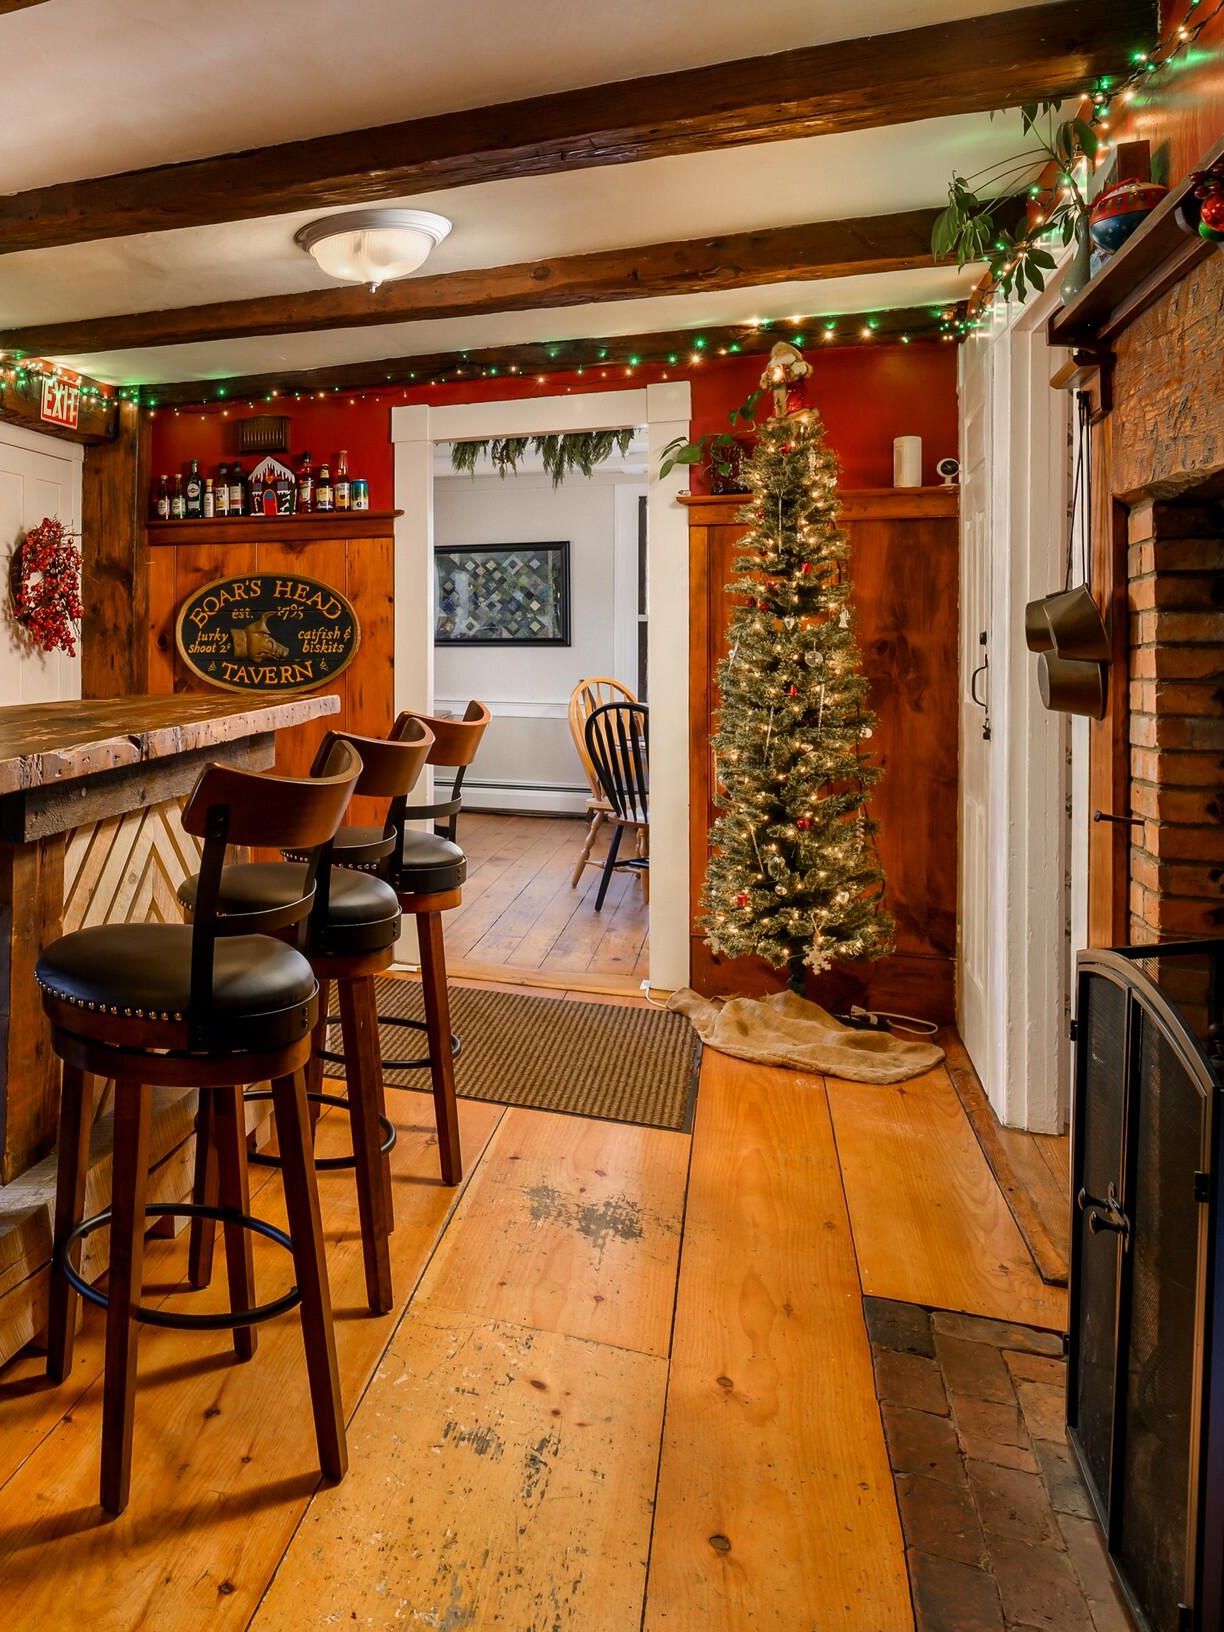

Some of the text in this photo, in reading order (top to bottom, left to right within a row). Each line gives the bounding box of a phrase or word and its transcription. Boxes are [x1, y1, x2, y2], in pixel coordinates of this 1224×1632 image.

[43, 379, 79, 423] EXIT
[189, 580, 342, 629] BOAR'S HEAD
[232, 603, 305, 620] est. 1795
[298, 626, 352, 645] catfish &
[188, 640, 216, 653] shoot
[302, 640, 345, 653] biskits
[222, 660, 314, 684] TAVERN
